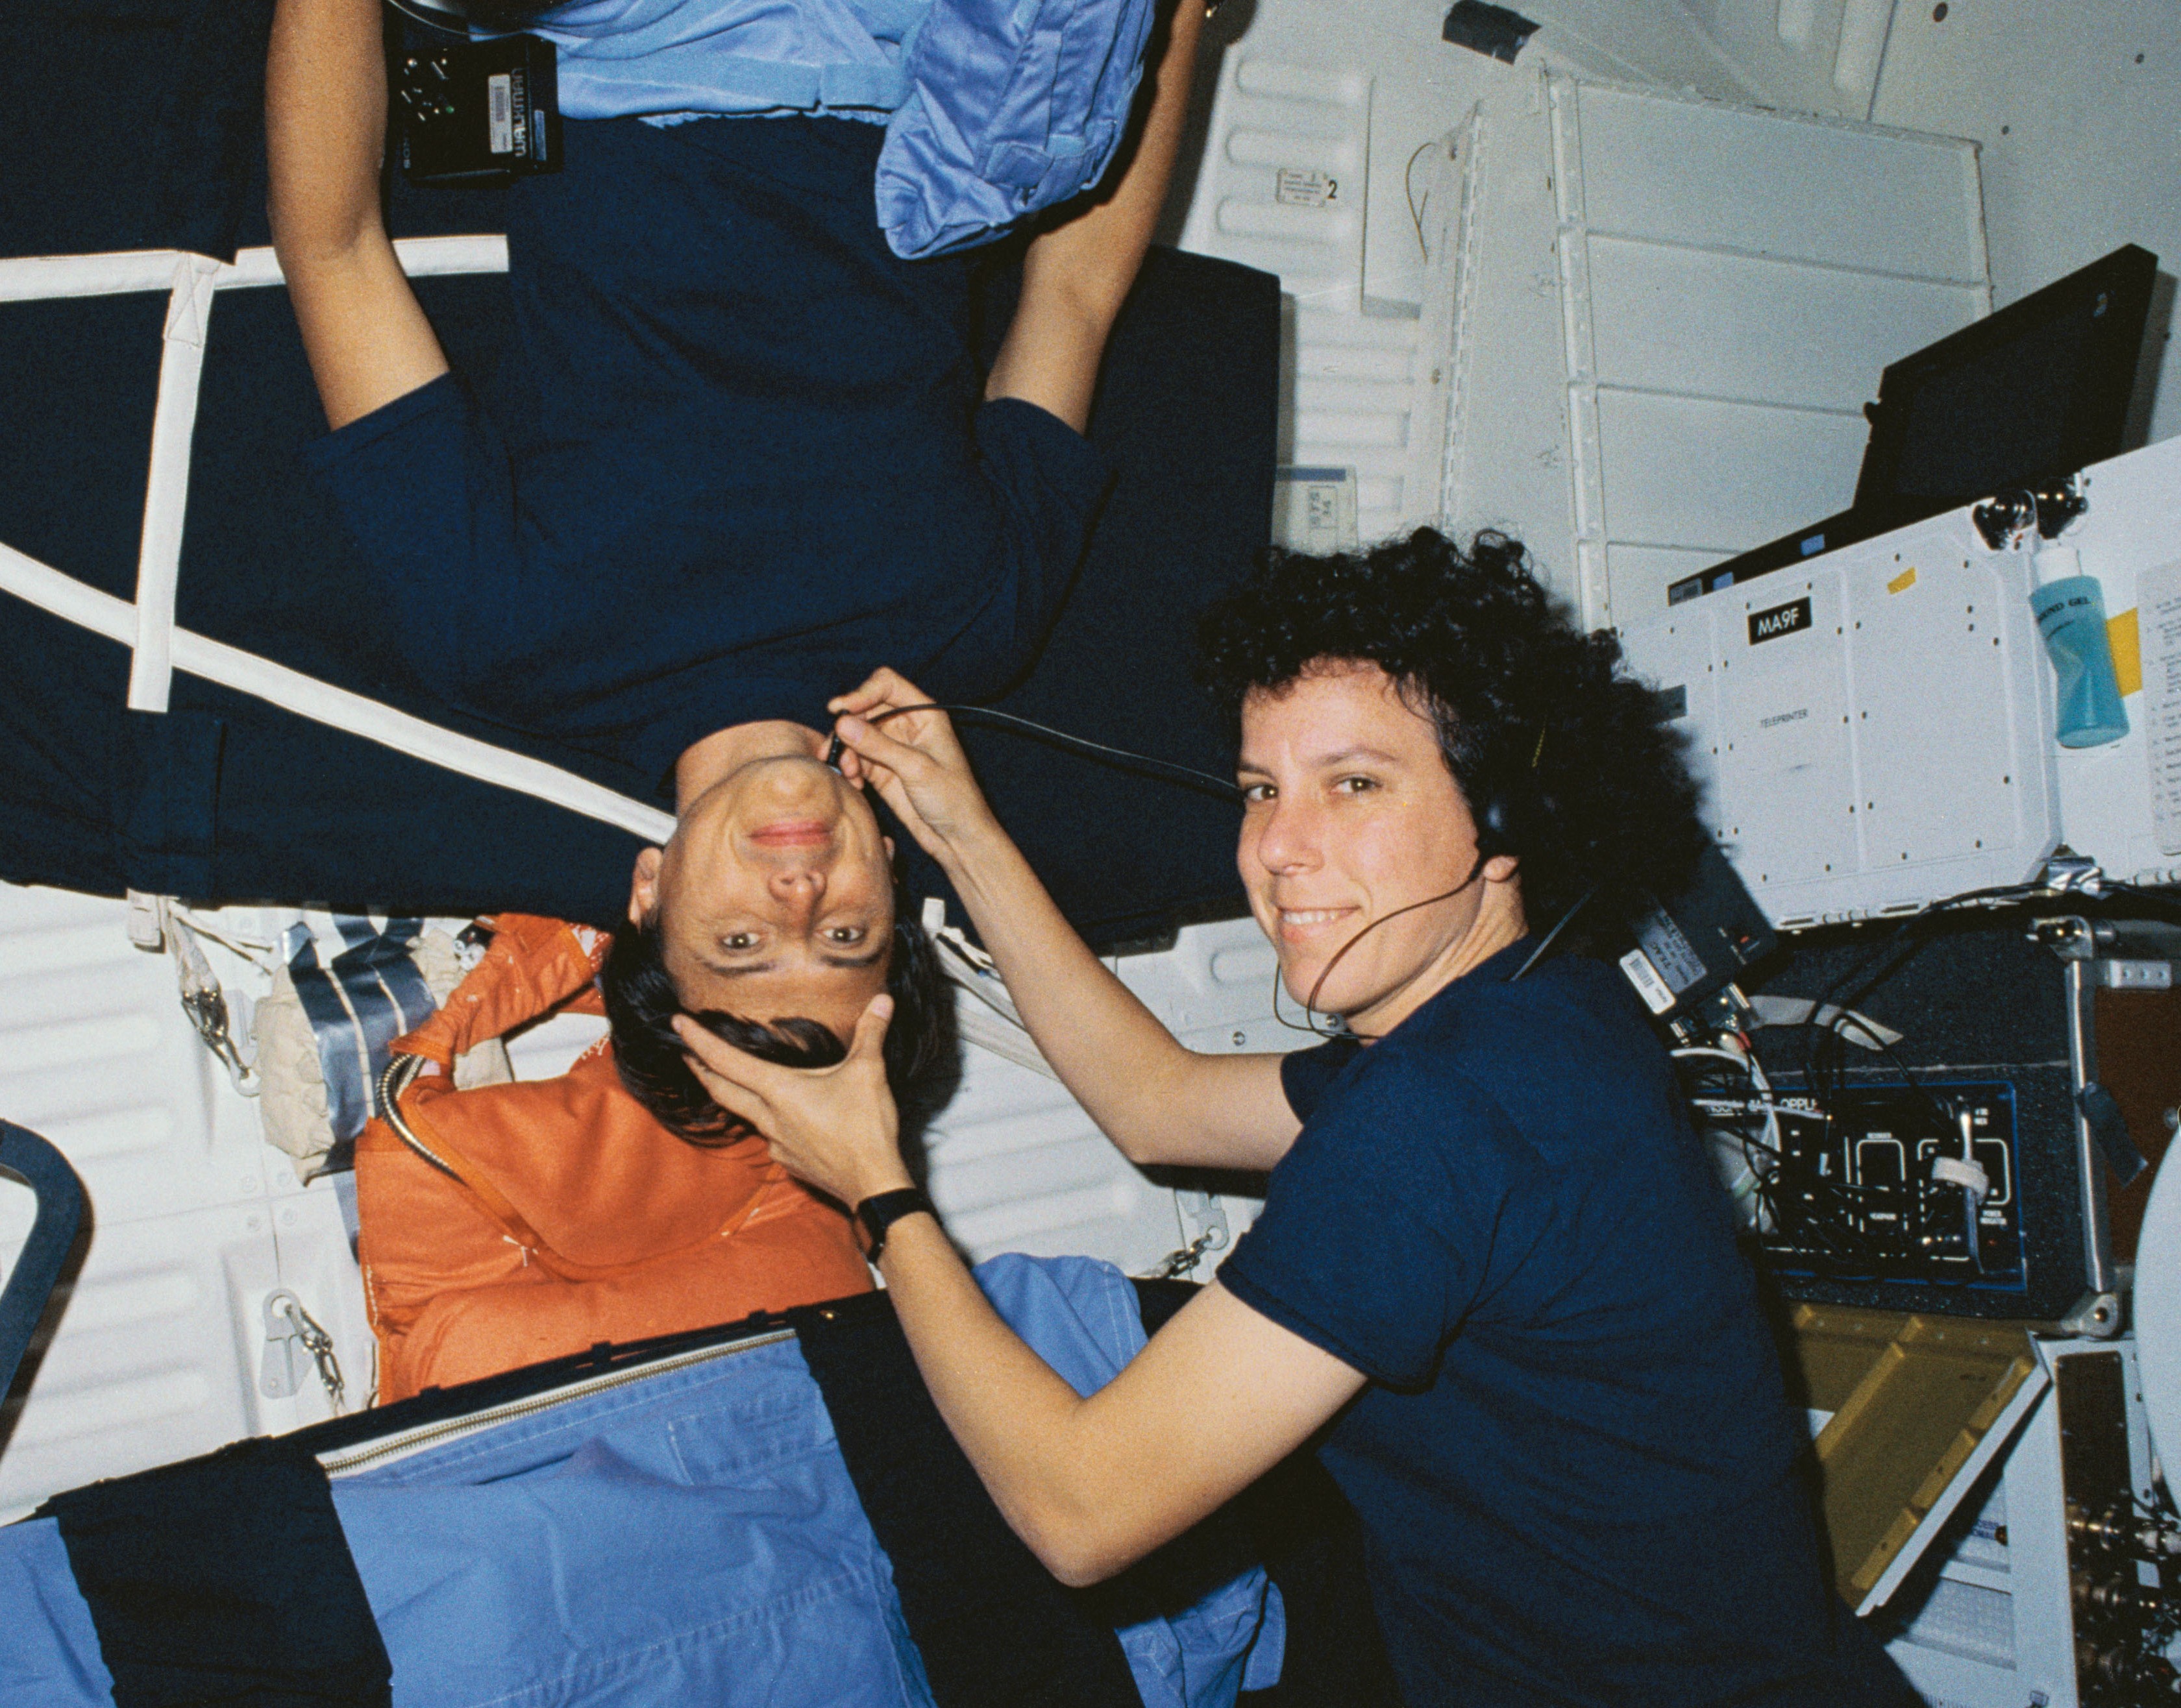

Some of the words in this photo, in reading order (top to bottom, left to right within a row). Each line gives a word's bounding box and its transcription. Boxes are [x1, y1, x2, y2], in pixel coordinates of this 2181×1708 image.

[511, 67, 527, 157] WALKMAN
[1327, 179, 1338, 199] 2
[1757, 607, 1800, 637] MA9F
[1760, 708, 1808, 729] TELEPRINTER
